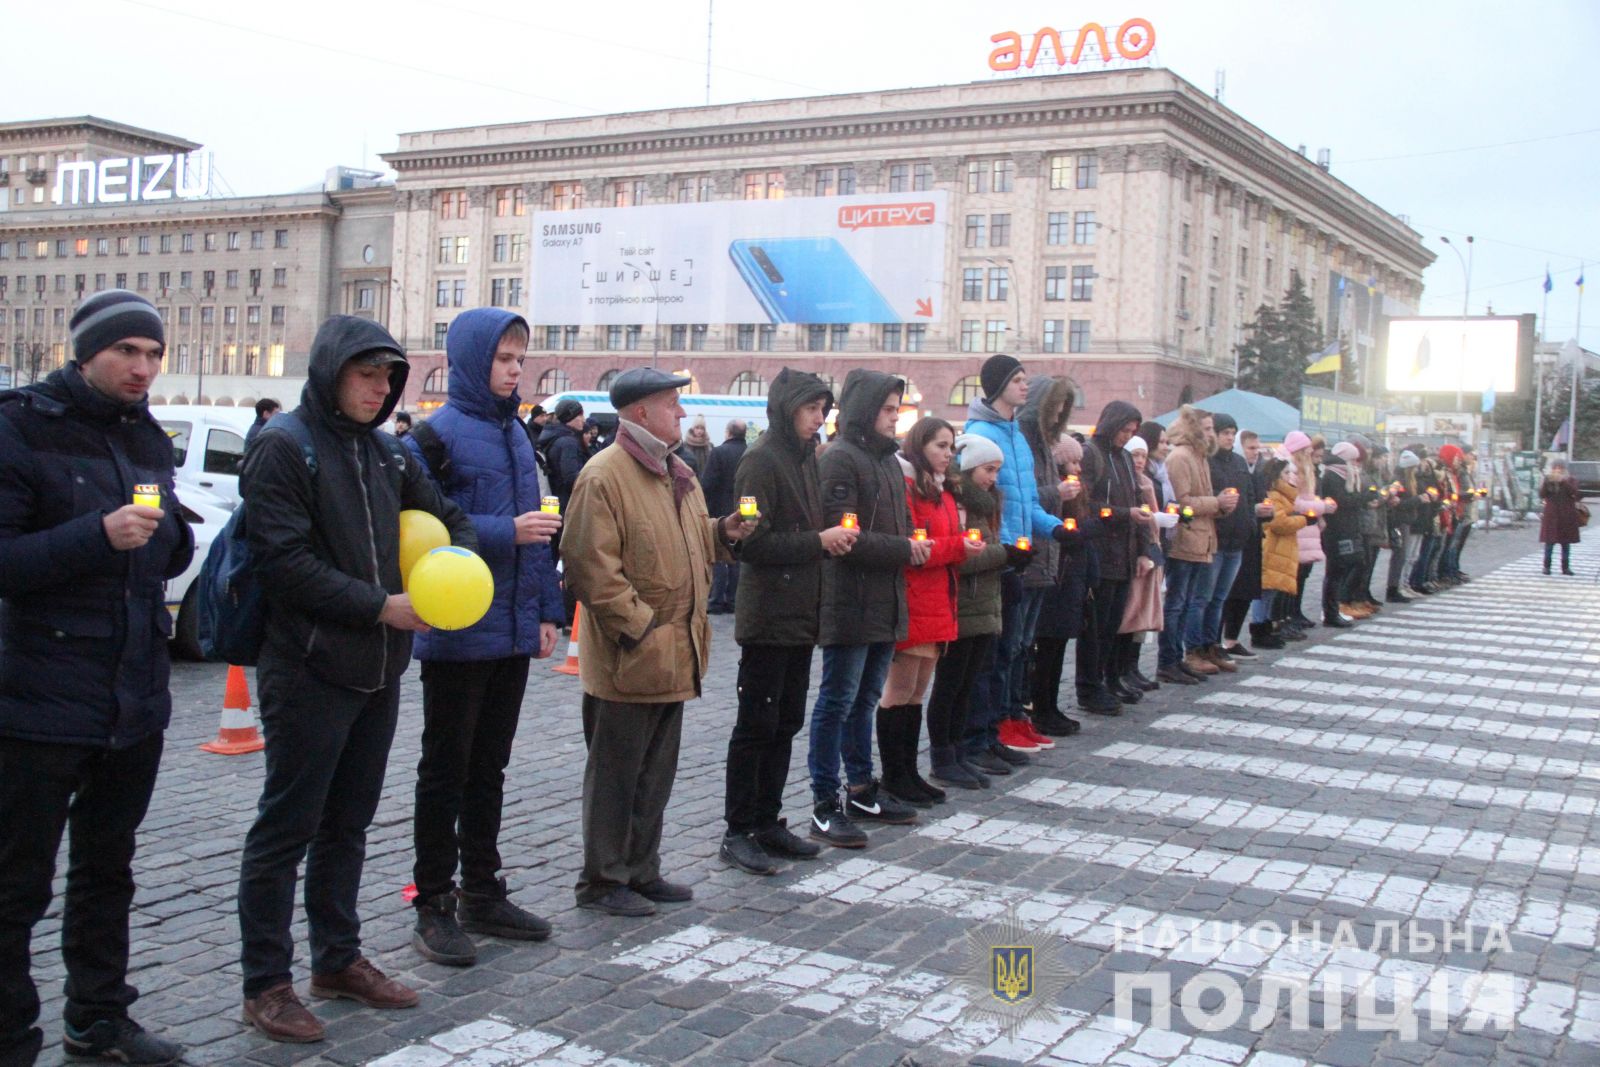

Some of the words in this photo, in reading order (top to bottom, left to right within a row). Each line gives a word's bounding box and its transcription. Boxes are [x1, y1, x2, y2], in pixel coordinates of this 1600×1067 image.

[55, 150, 210, 205] MEIZU
[841, 206, 931, 225] ЦИТРУС
[543, 222, 602, 236] SAMSUNG
[542, 238, 571, 249] Galaxy
[572, 237, 583, 247] A7
[620, 247, 636, 257] Твій
[638, 247, 655, 256] світ
[596, 269, 677, 283] ШИРШЕ
[594, 296, 640, 307] потрійною
[641, 295, 684, 306] камерою
